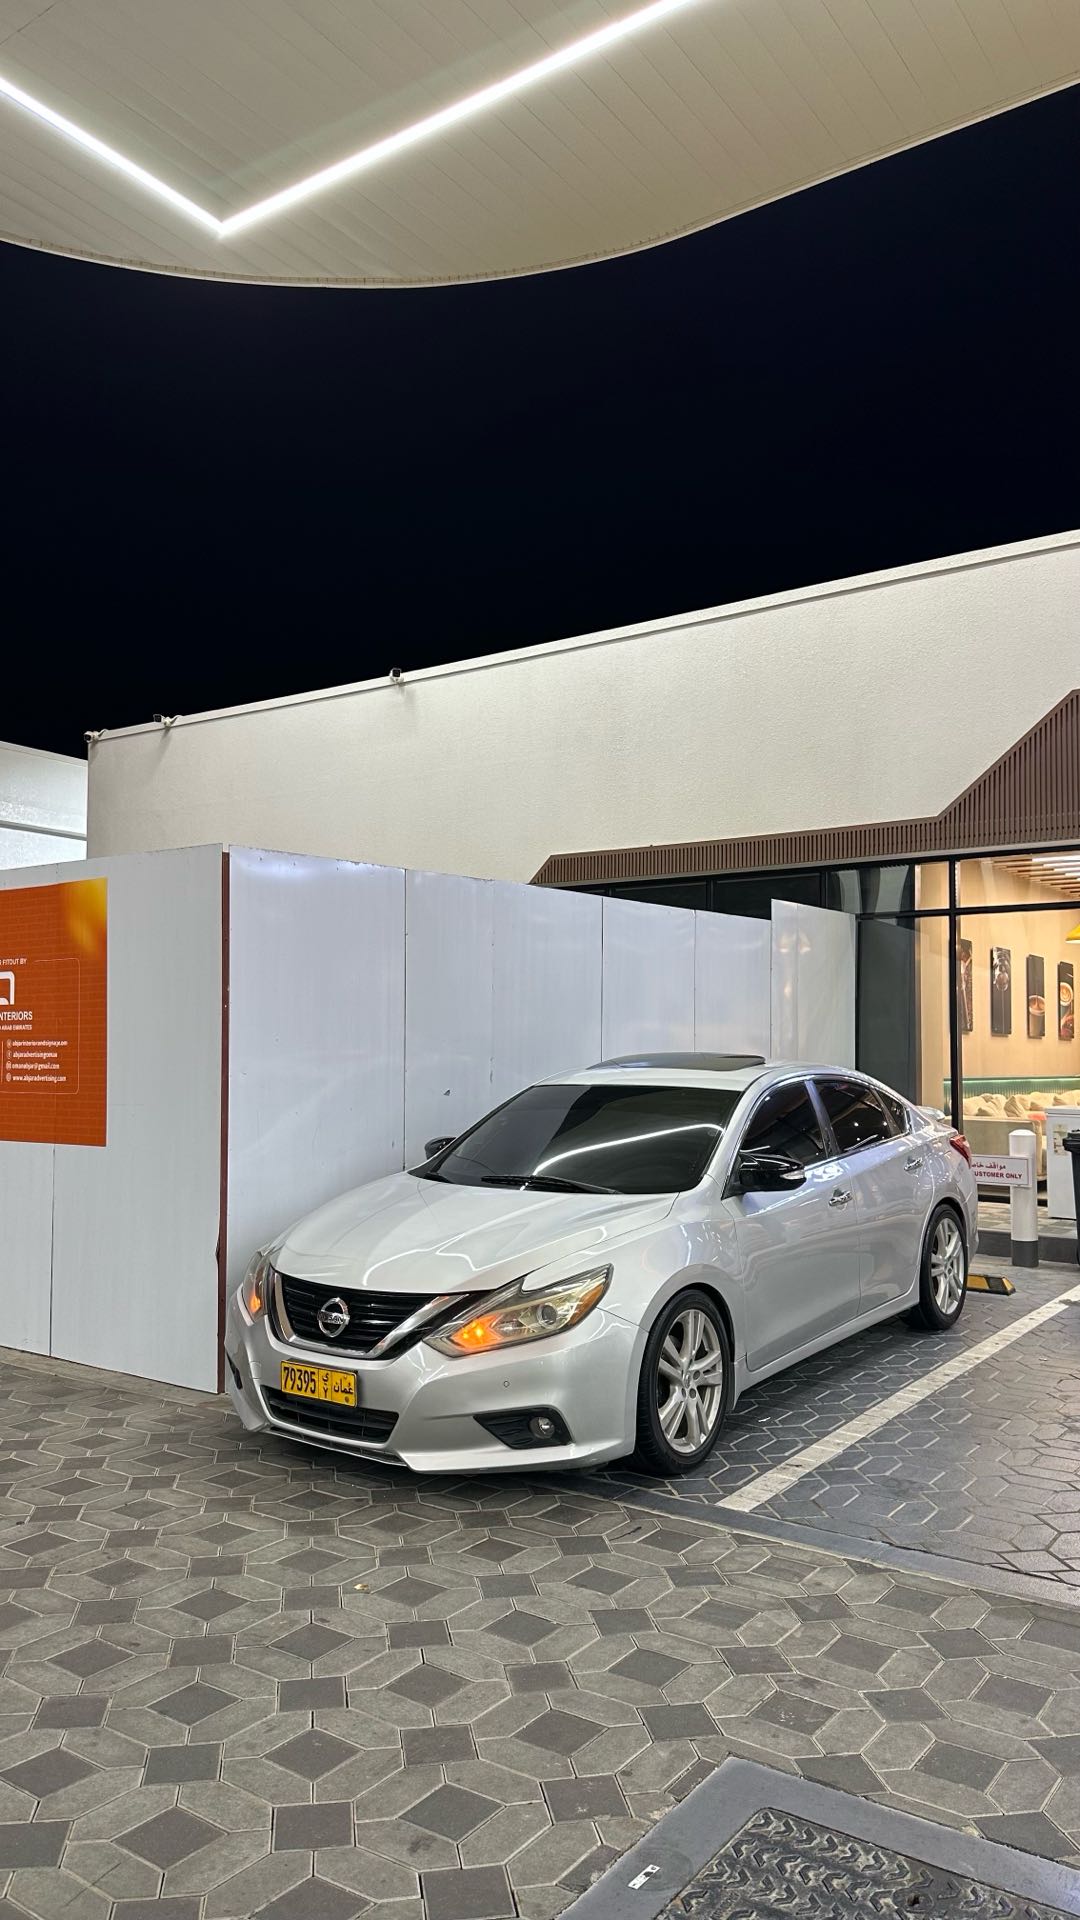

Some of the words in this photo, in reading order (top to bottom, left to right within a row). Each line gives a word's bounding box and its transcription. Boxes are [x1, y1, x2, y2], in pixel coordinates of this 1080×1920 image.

[0, 1011, 33, 1021] NTERIORS
[974, 1171, 1004, 1179] USTOMER
[1005, 1172, 1023, 1180] ONLY
[283, 1366, 317, 1394] 79395
